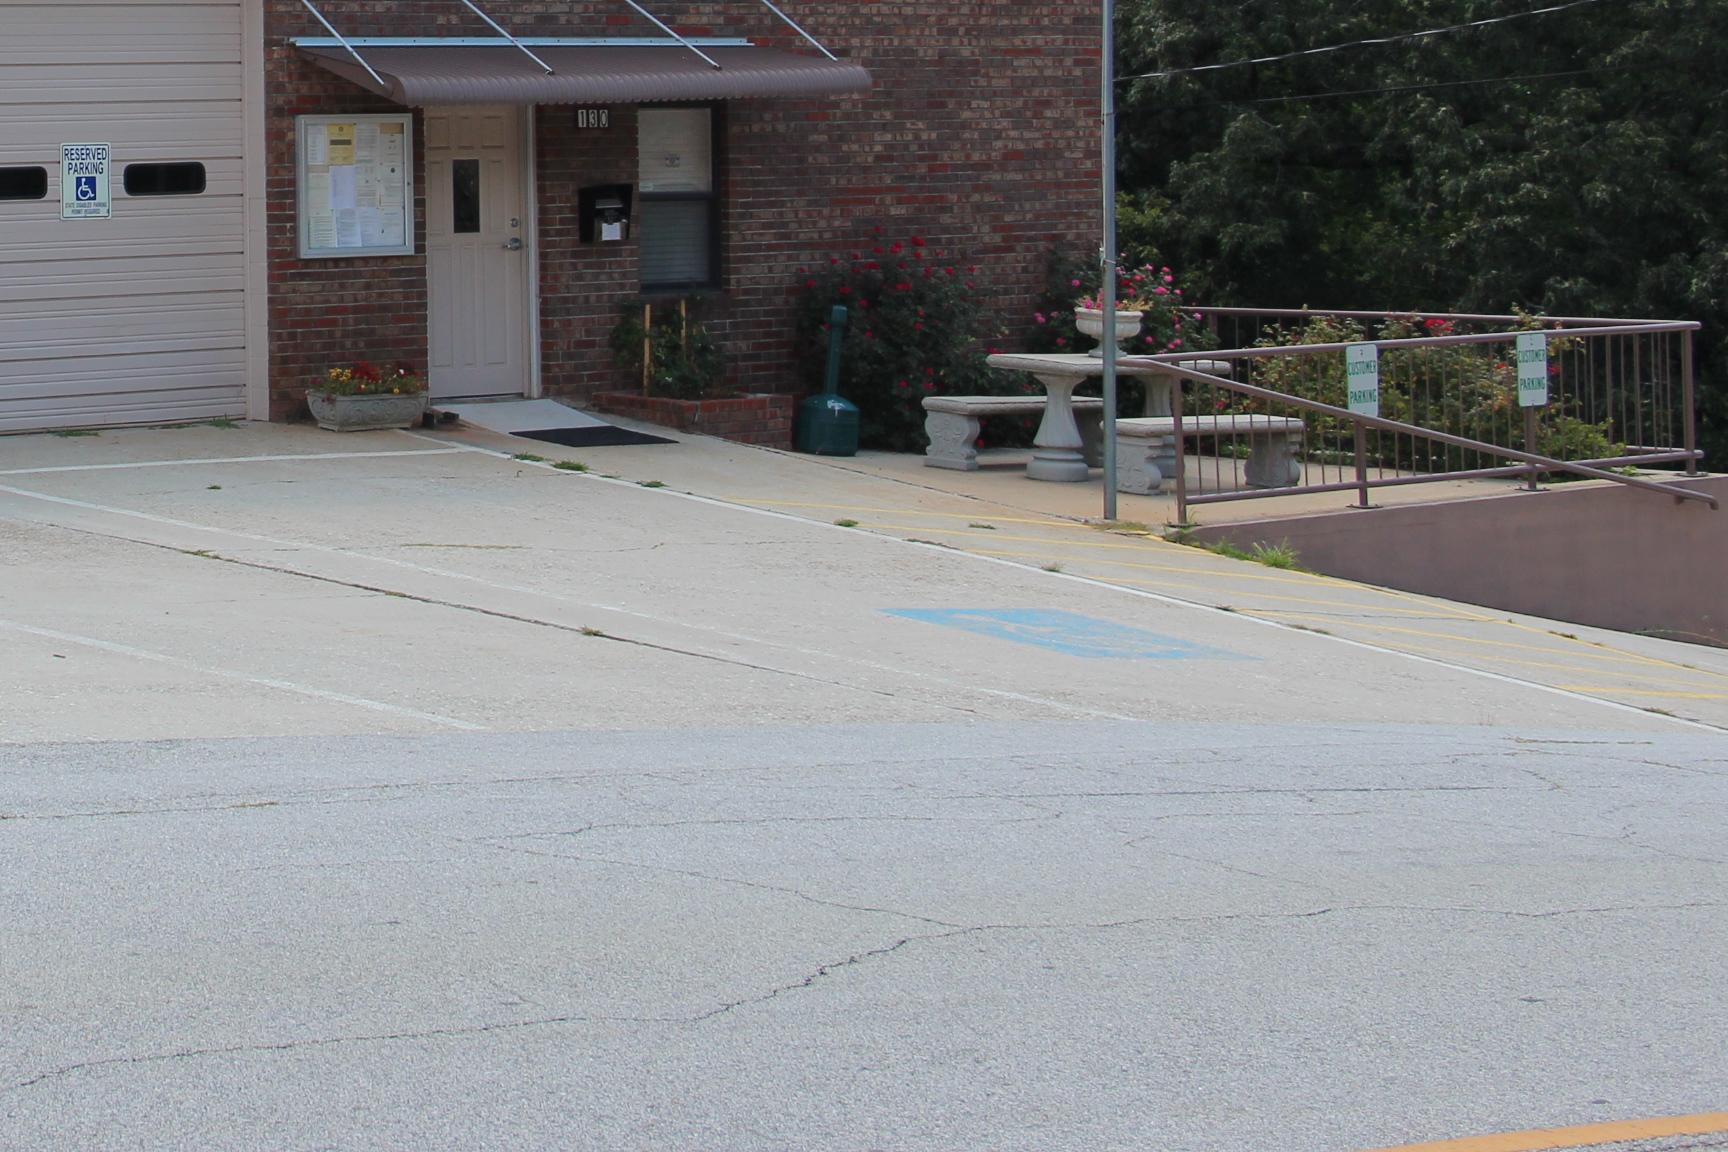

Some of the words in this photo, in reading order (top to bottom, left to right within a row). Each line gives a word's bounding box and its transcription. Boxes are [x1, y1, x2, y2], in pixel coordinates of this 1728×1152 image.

[578, 110, 608, 127] 130
[64, 147, 107, 161] RESERVED
[67, 161, 104, 175] PARKING
[1519, 349, 1545, 363] CUSTOMER
[1348, 360, 1376, 375] CUSTOMER
[1520, 376, 1545, 391] PARKING
[1350, 389, 1376, 404] PARKING
